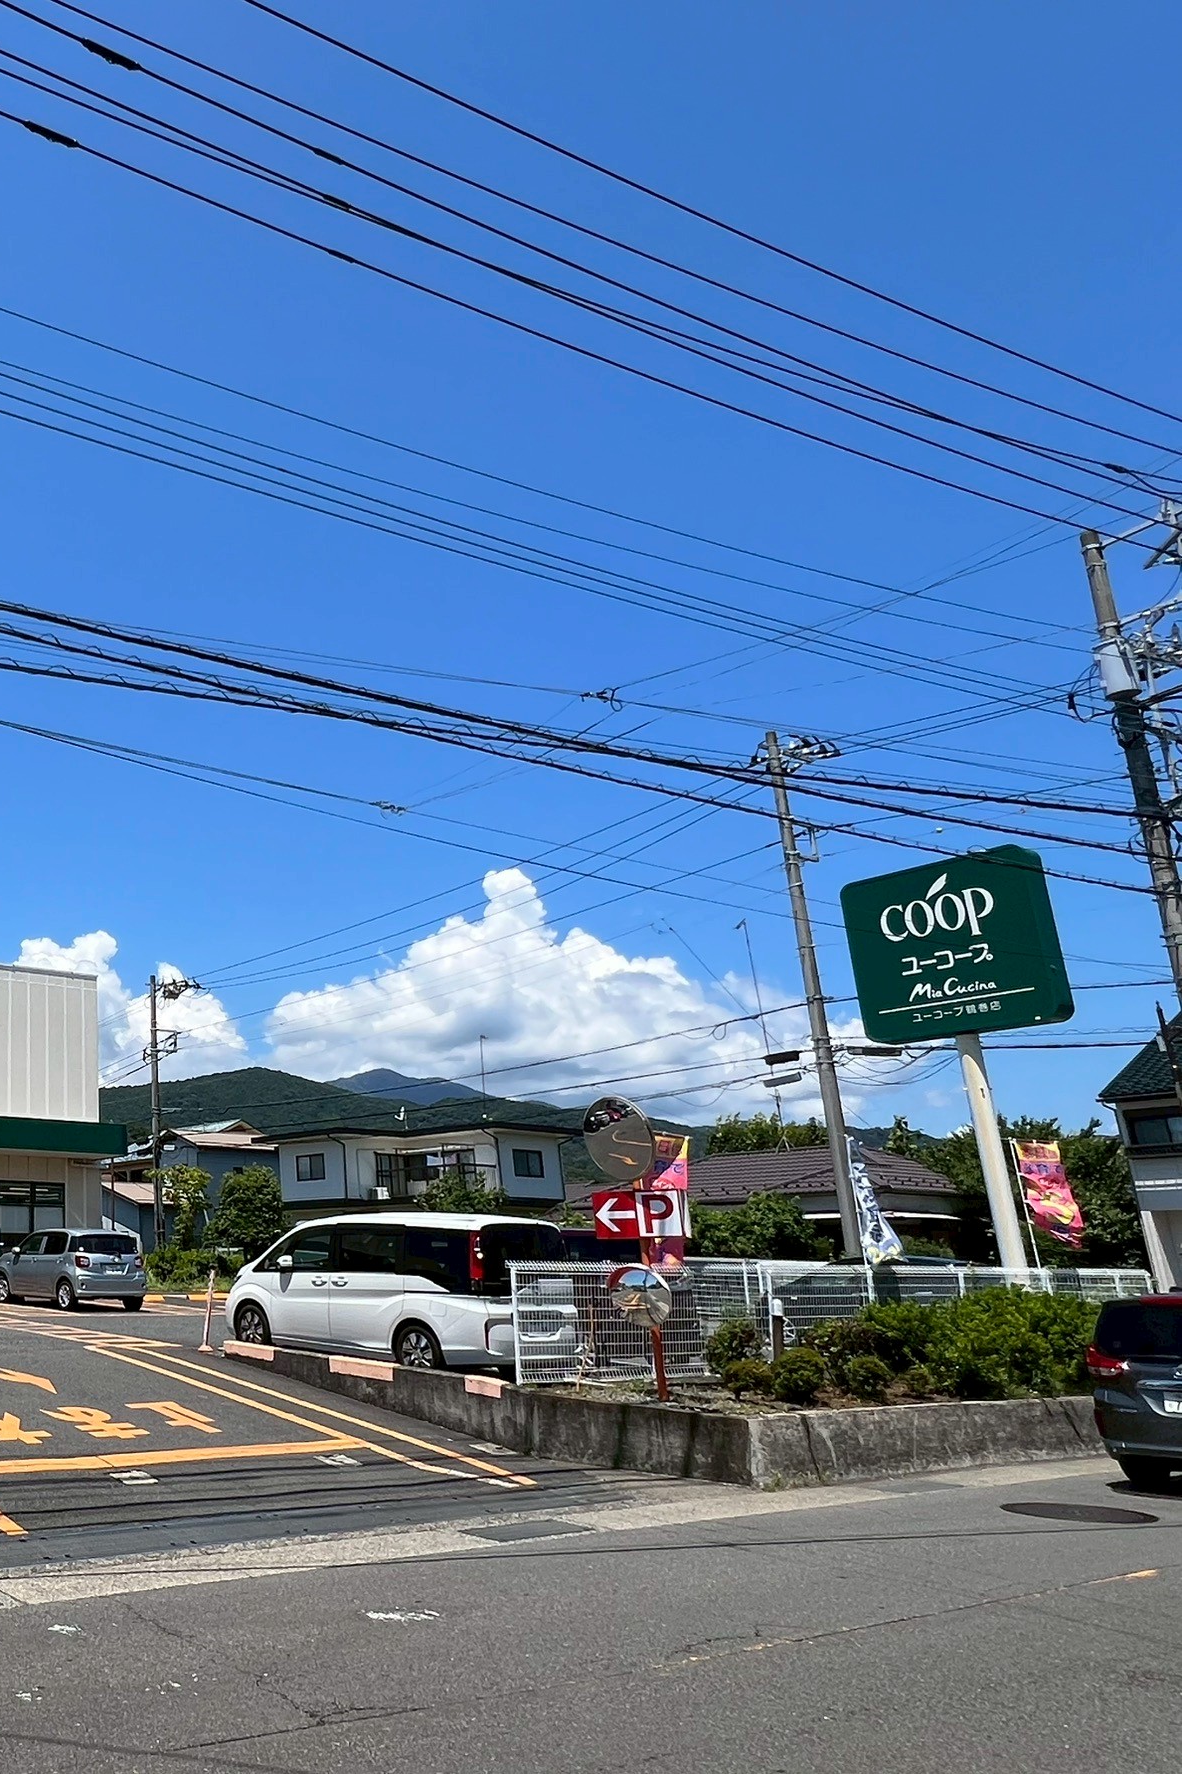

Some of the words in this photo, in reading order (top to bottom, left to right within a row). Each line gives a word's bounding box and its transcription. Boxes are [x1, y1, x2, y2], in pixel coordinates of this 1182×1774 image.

[901, 943, 994, 976] ユーコープ
[909, 982, 942, 1002] Mia
[943, 977, 997, 996] Cucina
[642, 1194, 674, 1233] P
